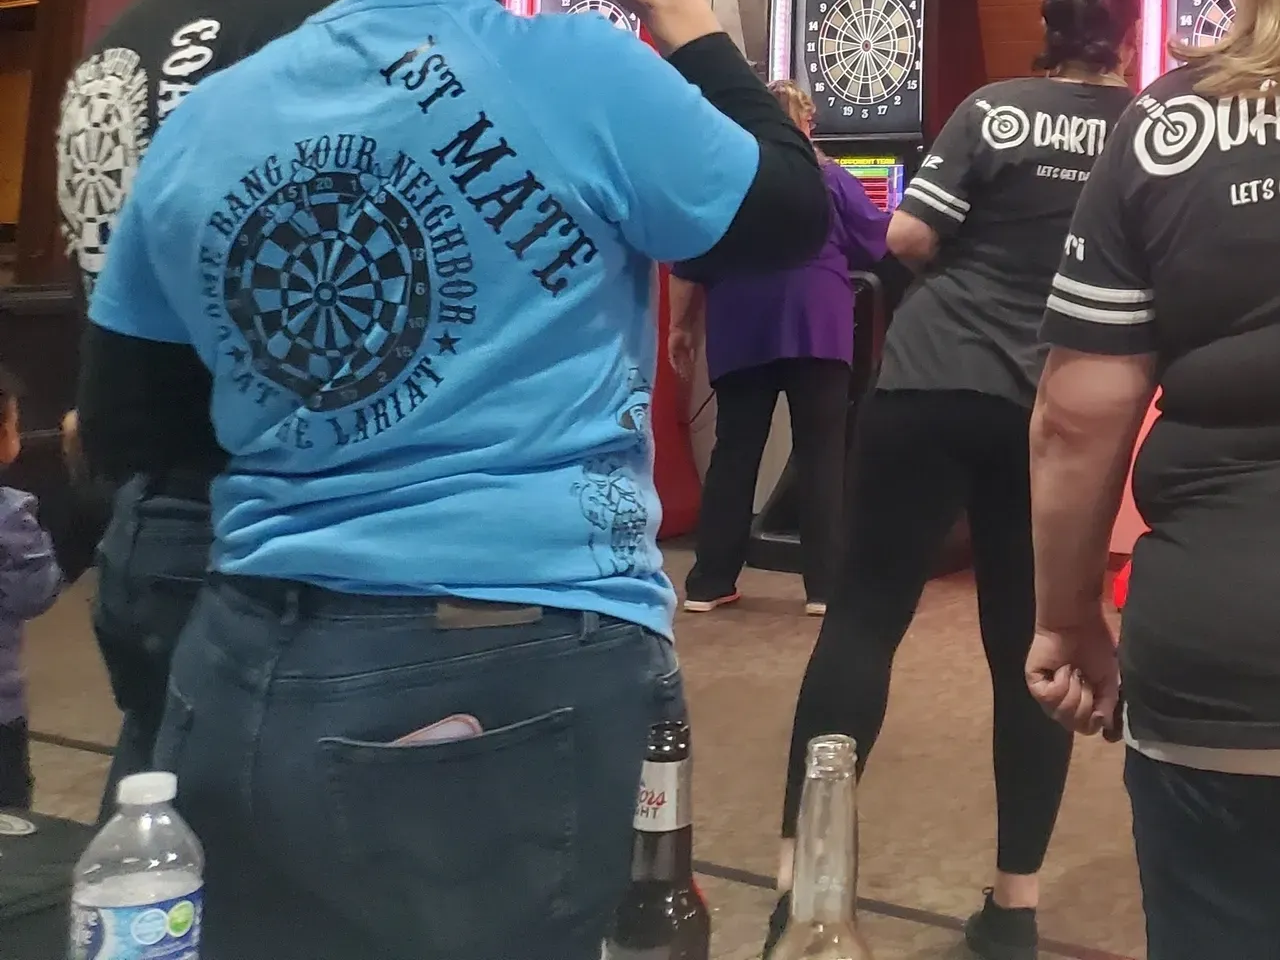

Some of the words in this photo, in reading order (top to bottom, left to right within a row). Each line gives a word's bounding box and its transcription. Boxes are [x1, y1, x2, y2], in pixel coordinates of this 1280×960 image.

[820, 3, 827, 12] 9
[909, 1, 916, 10] 4
[1180, 15, 1192, 26] 14
[808, 22, 818, 30] 14
[807, 42, 815, 51] 11
[810, 63, 817, 72] 8
[915, 62, 920, 70] 1
[815, 82, 824, 91] 16
[907, 80, 917, 89] 15
[828, 97, 835, 106] 7
[894, 96, 901, 105] 2
[843, 106, 853, 115] 19
[861, 109, 869, 118] 3
[877, 106, 888, 114] 17
[1060, 169, 1077, 181] GET
[1077, 170, 1091, 182] DA
[431, 111, 599, 297] MATE
[206, 154, 283, 236] BANG
[294, 134, 377, 172] YOUR
[387, 151, 478, 325] NEIGHBOR
[1065, 232, 1085, 261] ri
[640, 790, 667, 806] ors
[636, 807, 659, 819] HT
